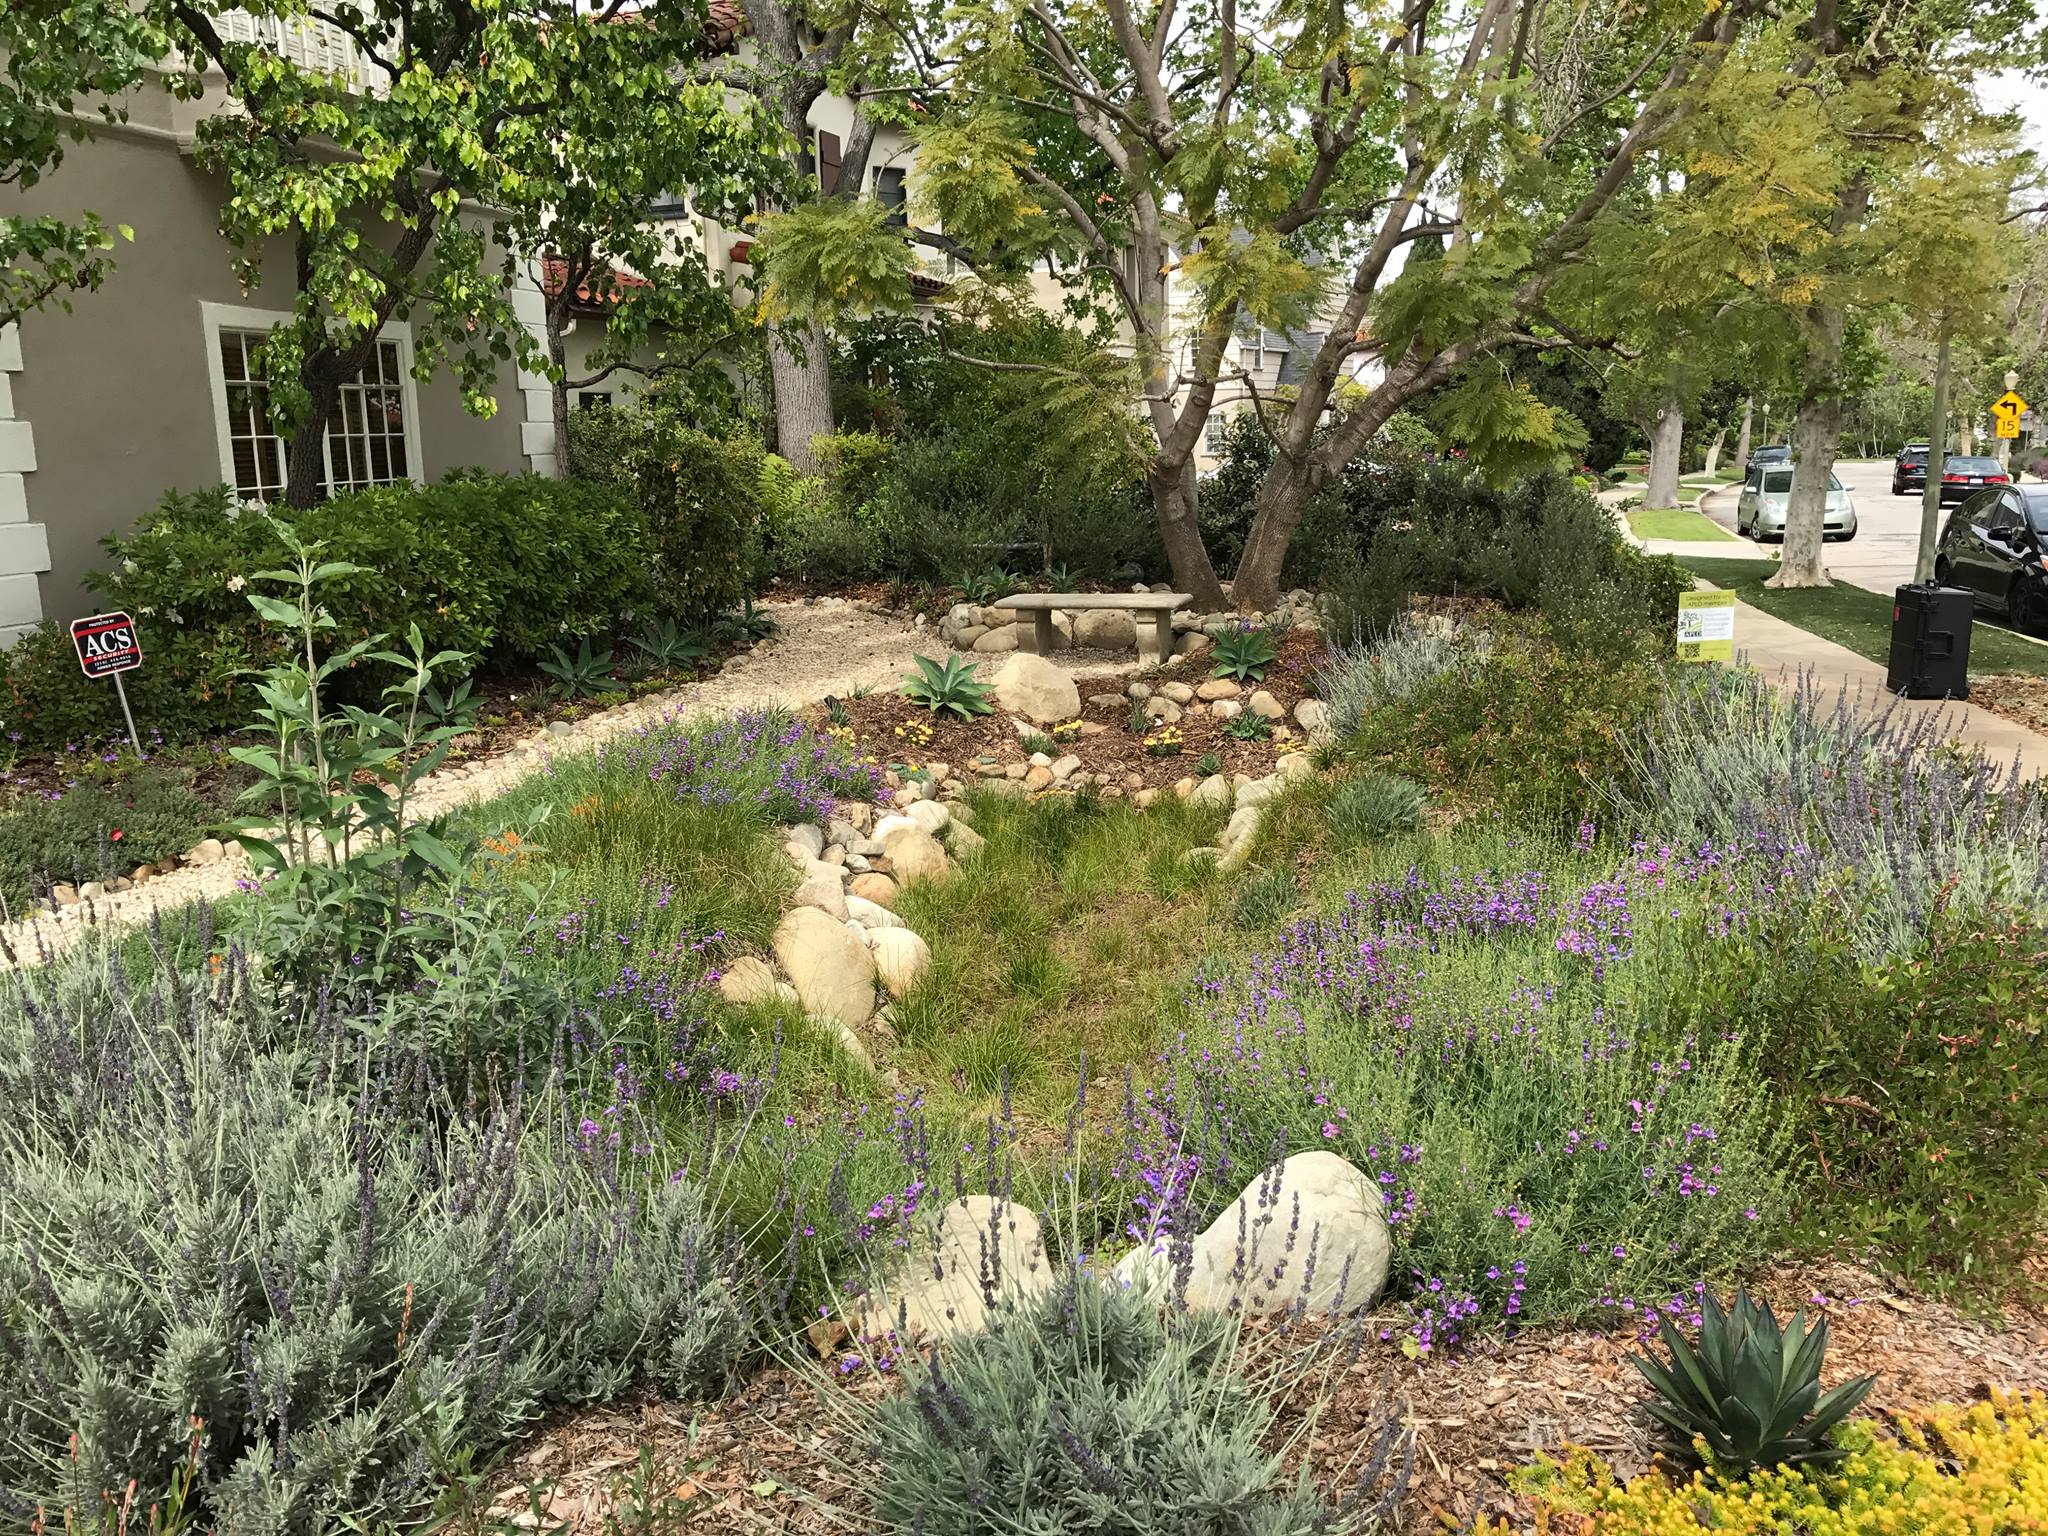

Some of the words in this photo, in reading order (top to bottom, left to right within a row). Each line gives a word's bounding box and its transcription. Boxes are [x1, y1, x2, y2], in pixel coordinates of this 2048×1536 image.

[2002, 421, 2015, 431] 15
[86, 628, 131, 657] ACS
[92, 649, 129, 661] SECURITY
